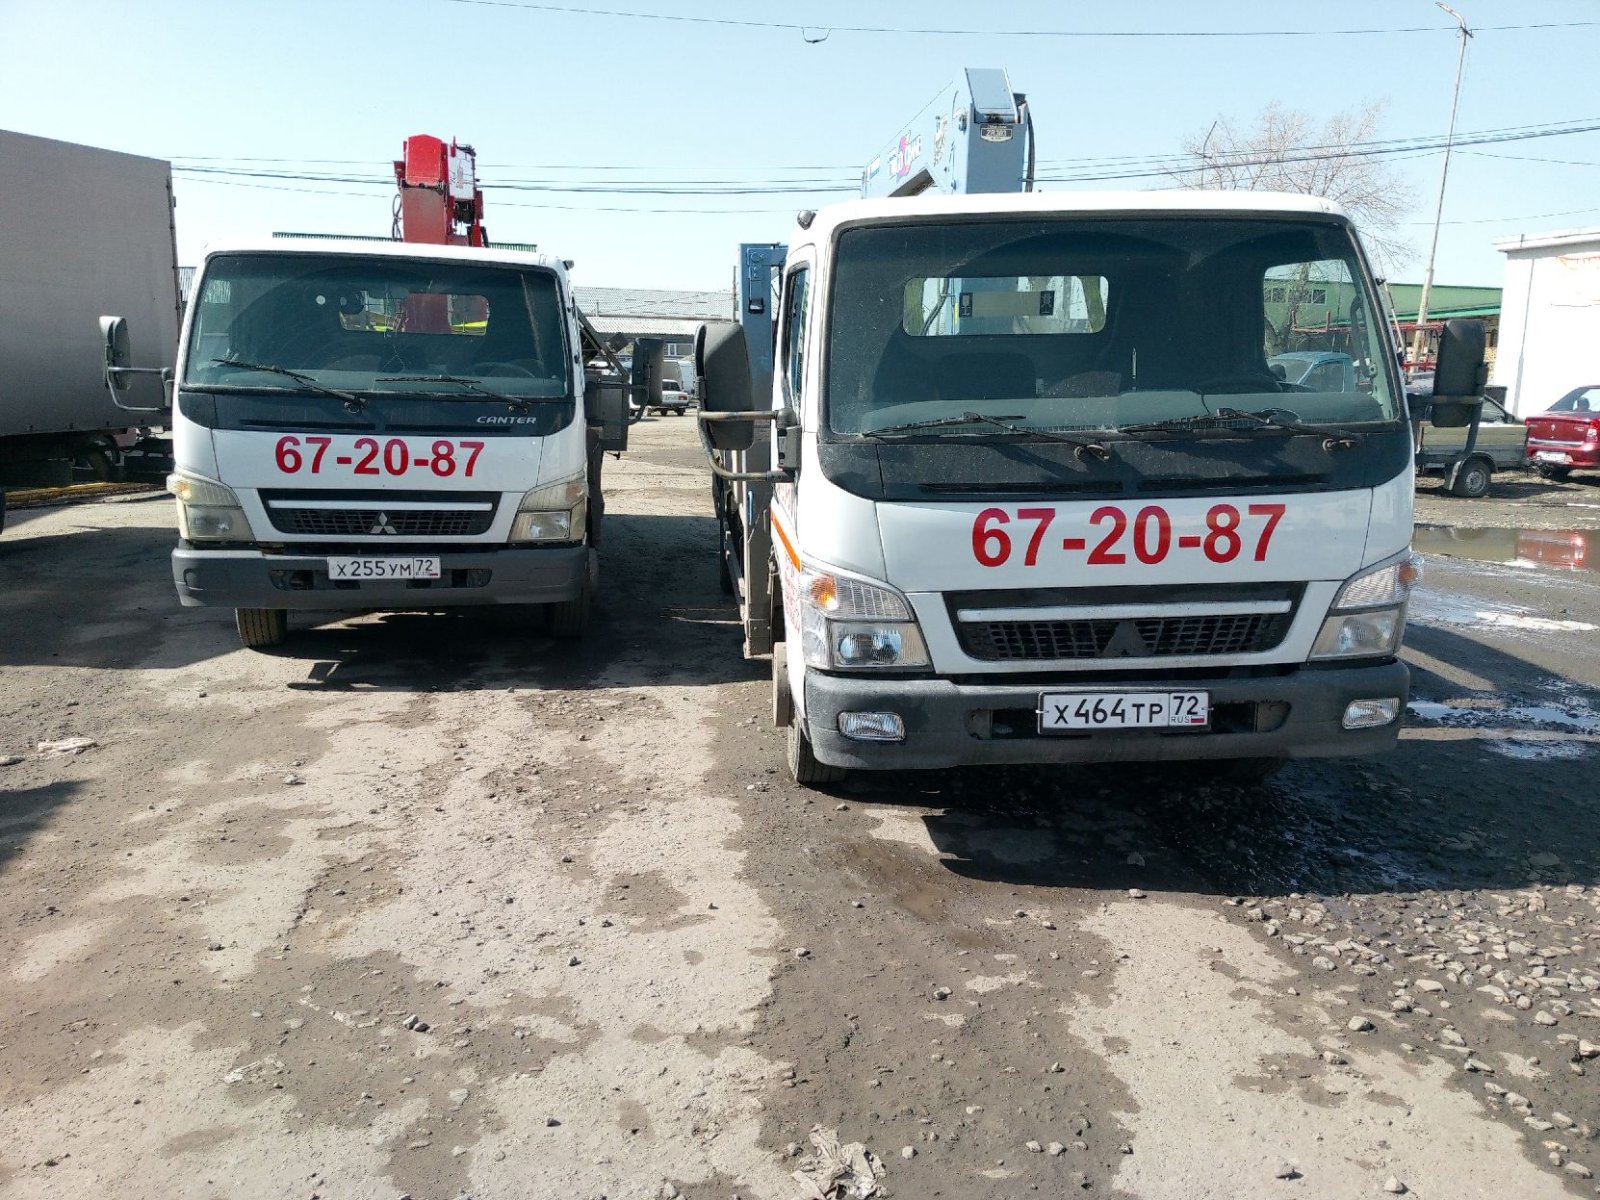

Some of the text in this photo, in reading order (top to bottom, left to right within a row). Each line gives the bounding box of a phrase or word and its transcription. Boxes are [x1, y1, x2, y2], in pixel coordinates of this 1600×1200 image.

[476, 416, 537, 424] CANTER
[275, 435, 485, 477] 67-20-87
[971, 503, 1286, 567] 67-20-87
[415, 559, 433, 572] 72
[1172, 695, 1199, 716] 72
[1170, 715, 1191, 724] RUS
